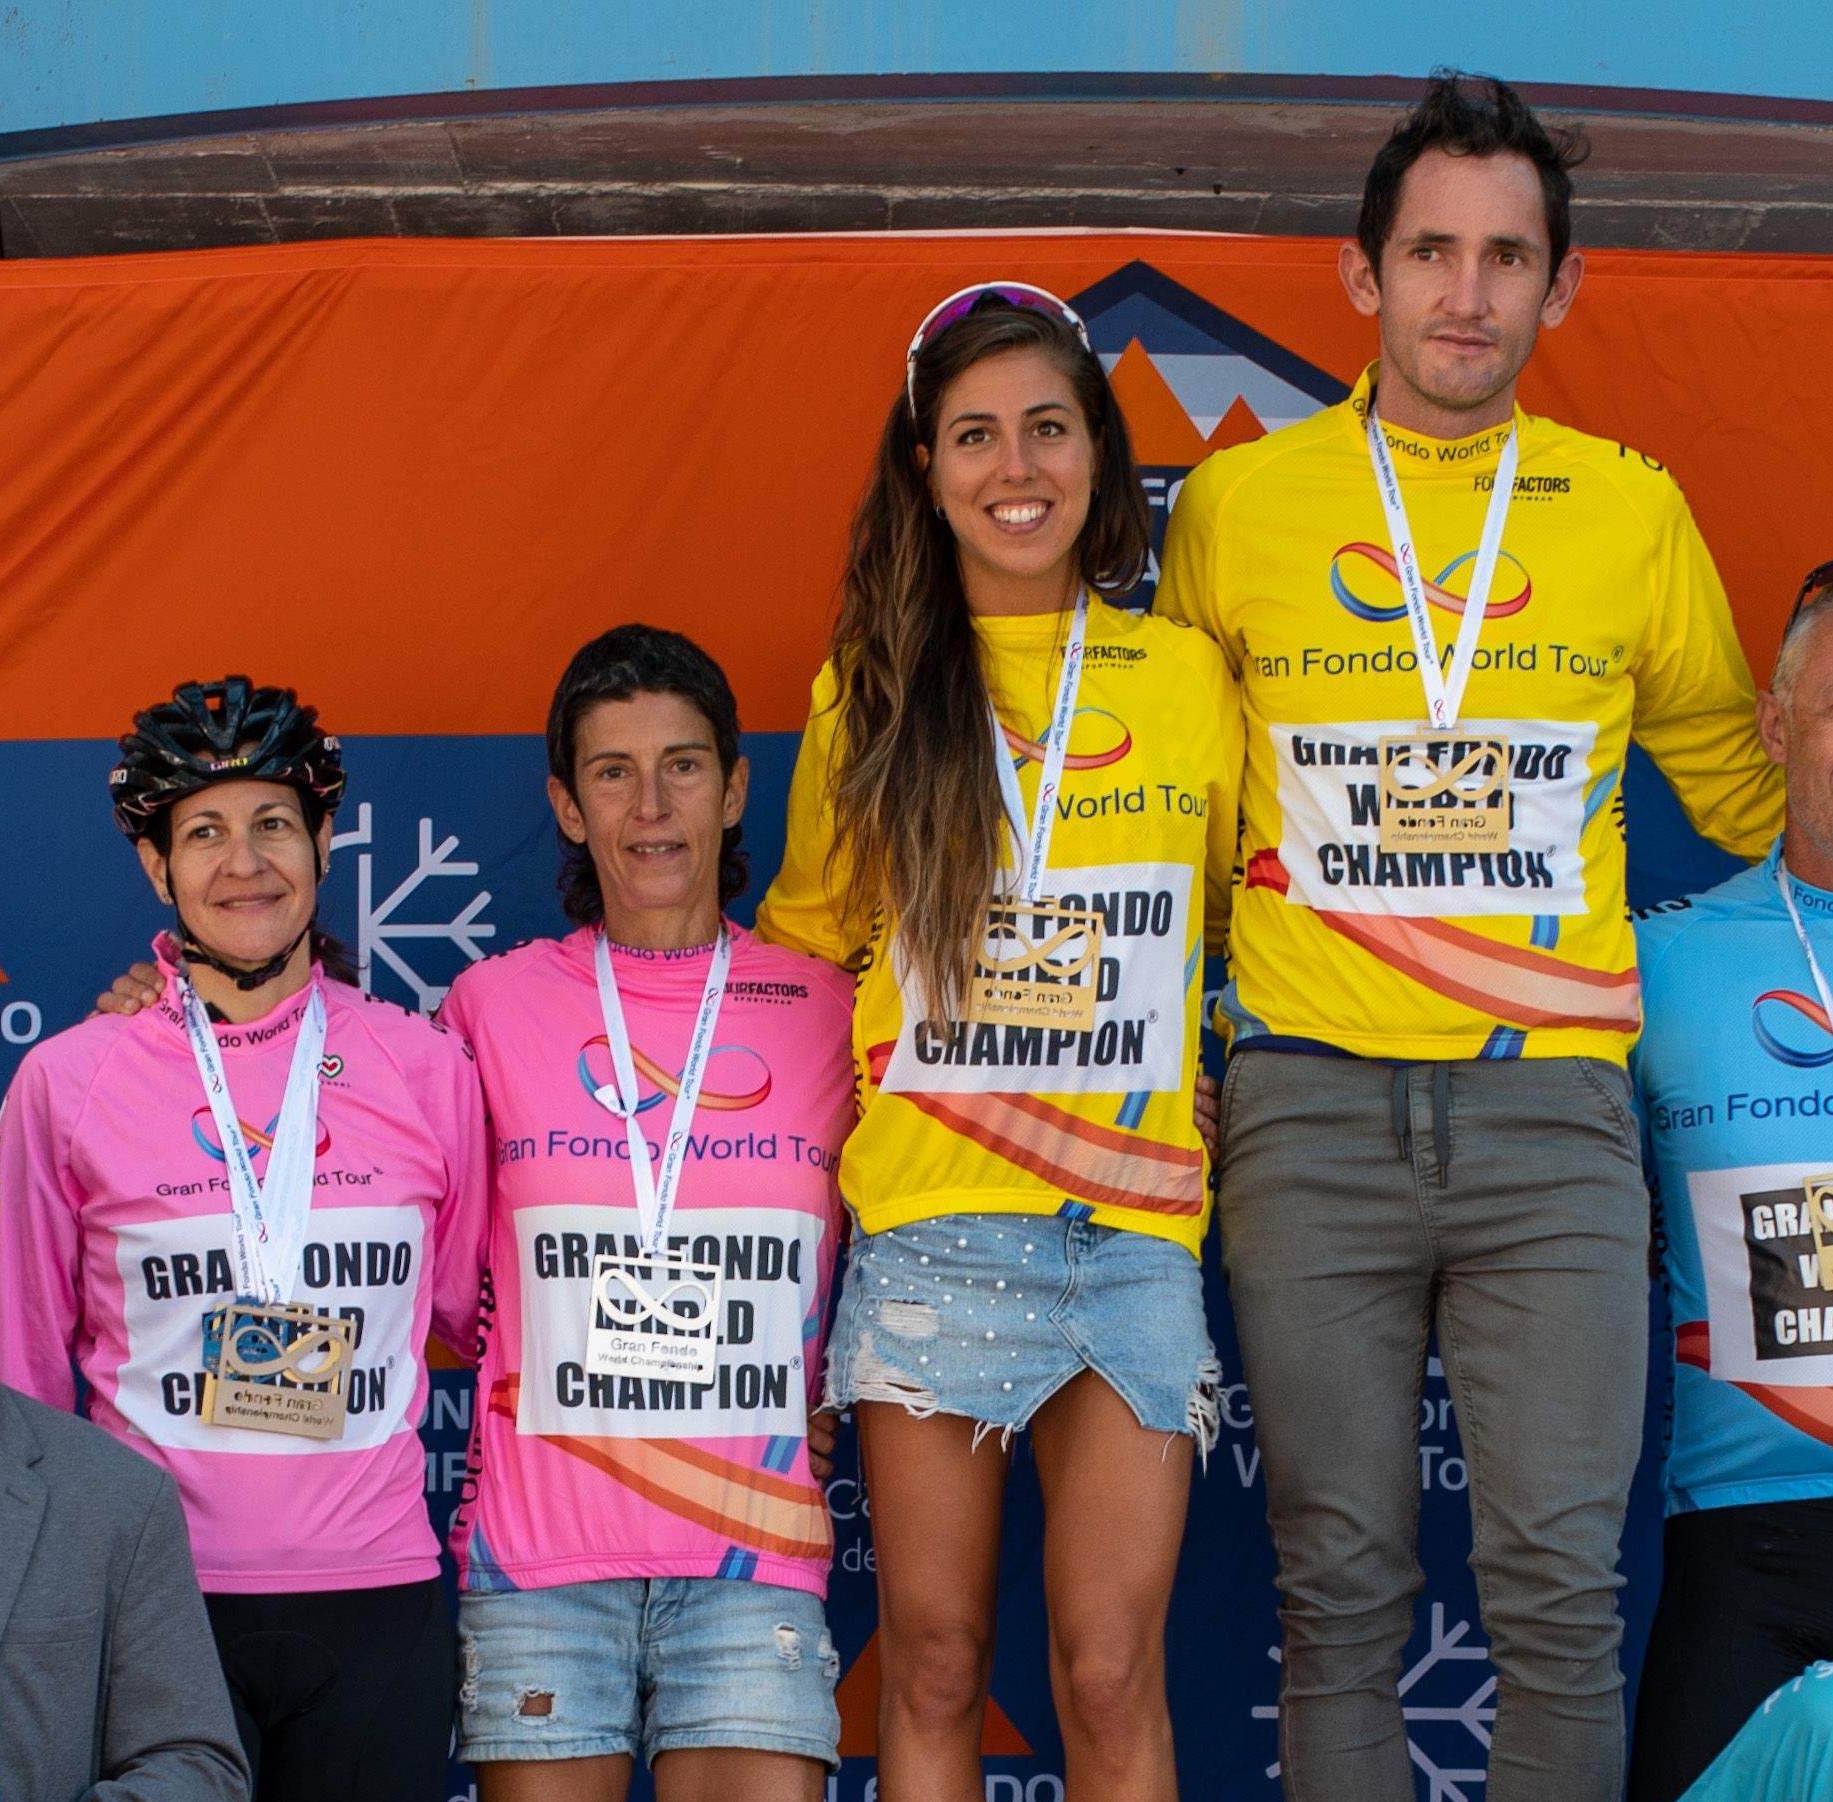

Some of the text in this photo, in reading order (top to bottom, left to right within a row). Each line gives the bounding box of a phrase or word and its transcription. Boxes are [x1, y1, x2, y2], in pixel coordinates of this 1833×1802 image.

[1437, 436, 1492, 462] World
[1474, 475, 1571, 494] FOFACTORS
[1254, 652, 1290, 678] ran
[1302, 643, 1419, 676] Fondo
[1156, 783, 1207, 820] Tour
[723, 981, 809, 999] OURFACTORS
[787, 1135, 839, 1174] Tour
[156, 1179, 203, 1197] Gran
[141, 1241, 412, 1301] GRA ONDO
[534, 1232, 653, 1281] GRAN
[610, 1337, 647, 1352] Gran
